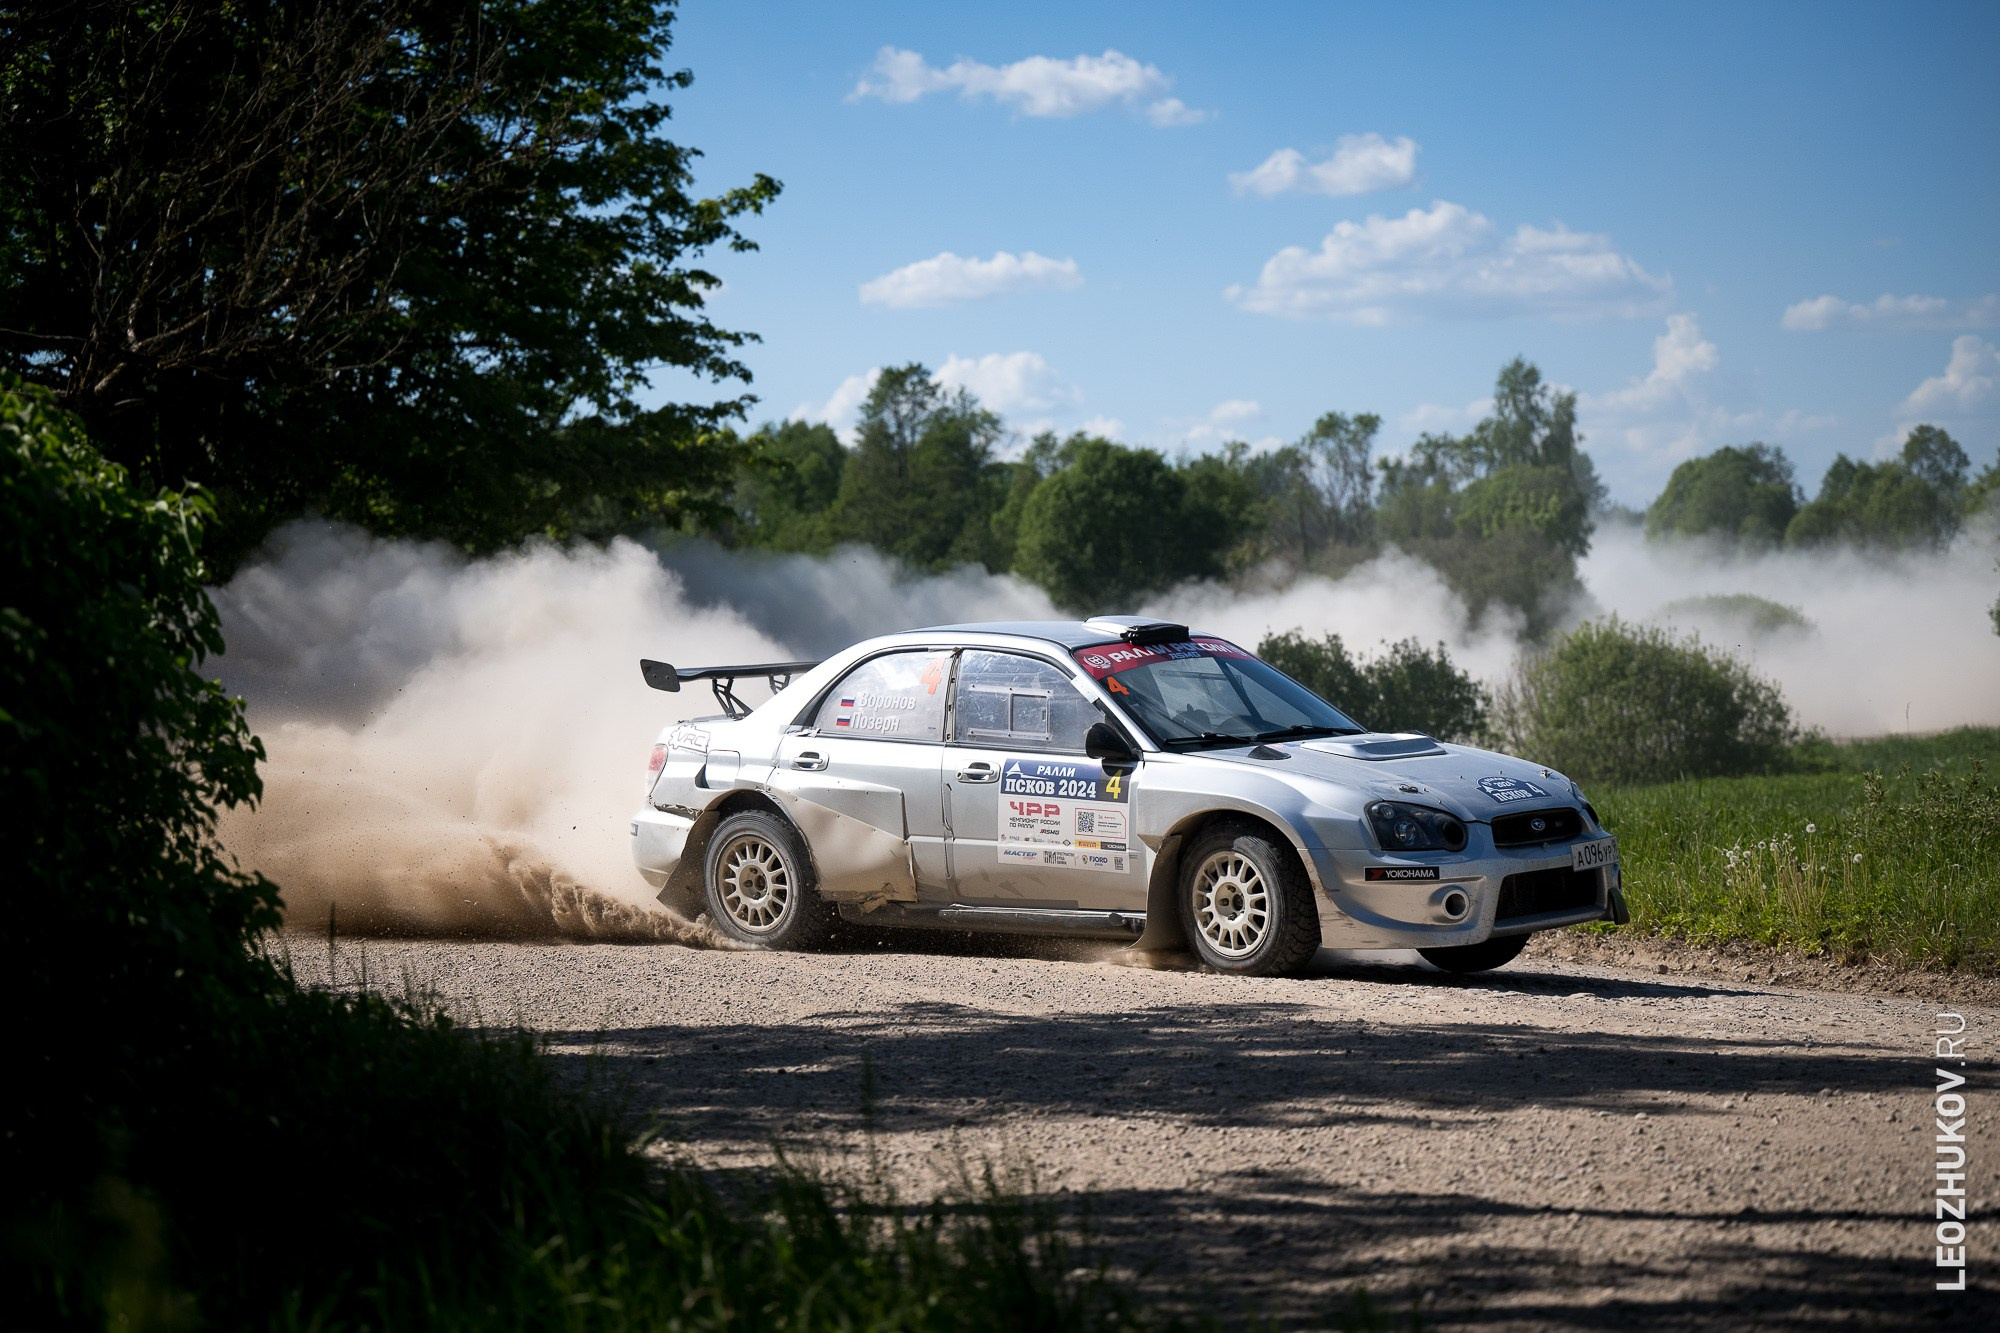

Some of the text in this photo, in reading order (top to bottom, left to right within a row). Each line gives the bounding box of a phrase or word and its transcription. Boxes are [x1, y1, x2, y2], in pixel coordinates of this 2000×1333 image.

[1108, 642, 1233, 662] РАЛЛИ РОССИИ
[921, 658, 946, 695] 4
[1107, 676, 1130, 696] 4
[859, 691, 918, 711] Воронов
[849, 711, 900, 734] Позерн
[676, 731, 706, 747] VRC
[1036, 765, 1076, 778] РАЛЛИ
[1004, 778, 1097, 799] ПСКОВ 2024
[1105, 769, 1123, 800] 4
[1492, 782, 1546, 802] ПСКОВ 4
[1009, 801, 1061, 818] ЧРР
[1009, 816, 1039, 824] ЧЕМПИОНАТ
[1089, 855, 1109, 864] FJORD
[1385, 869, 1435, 878] YOKOHAMA
